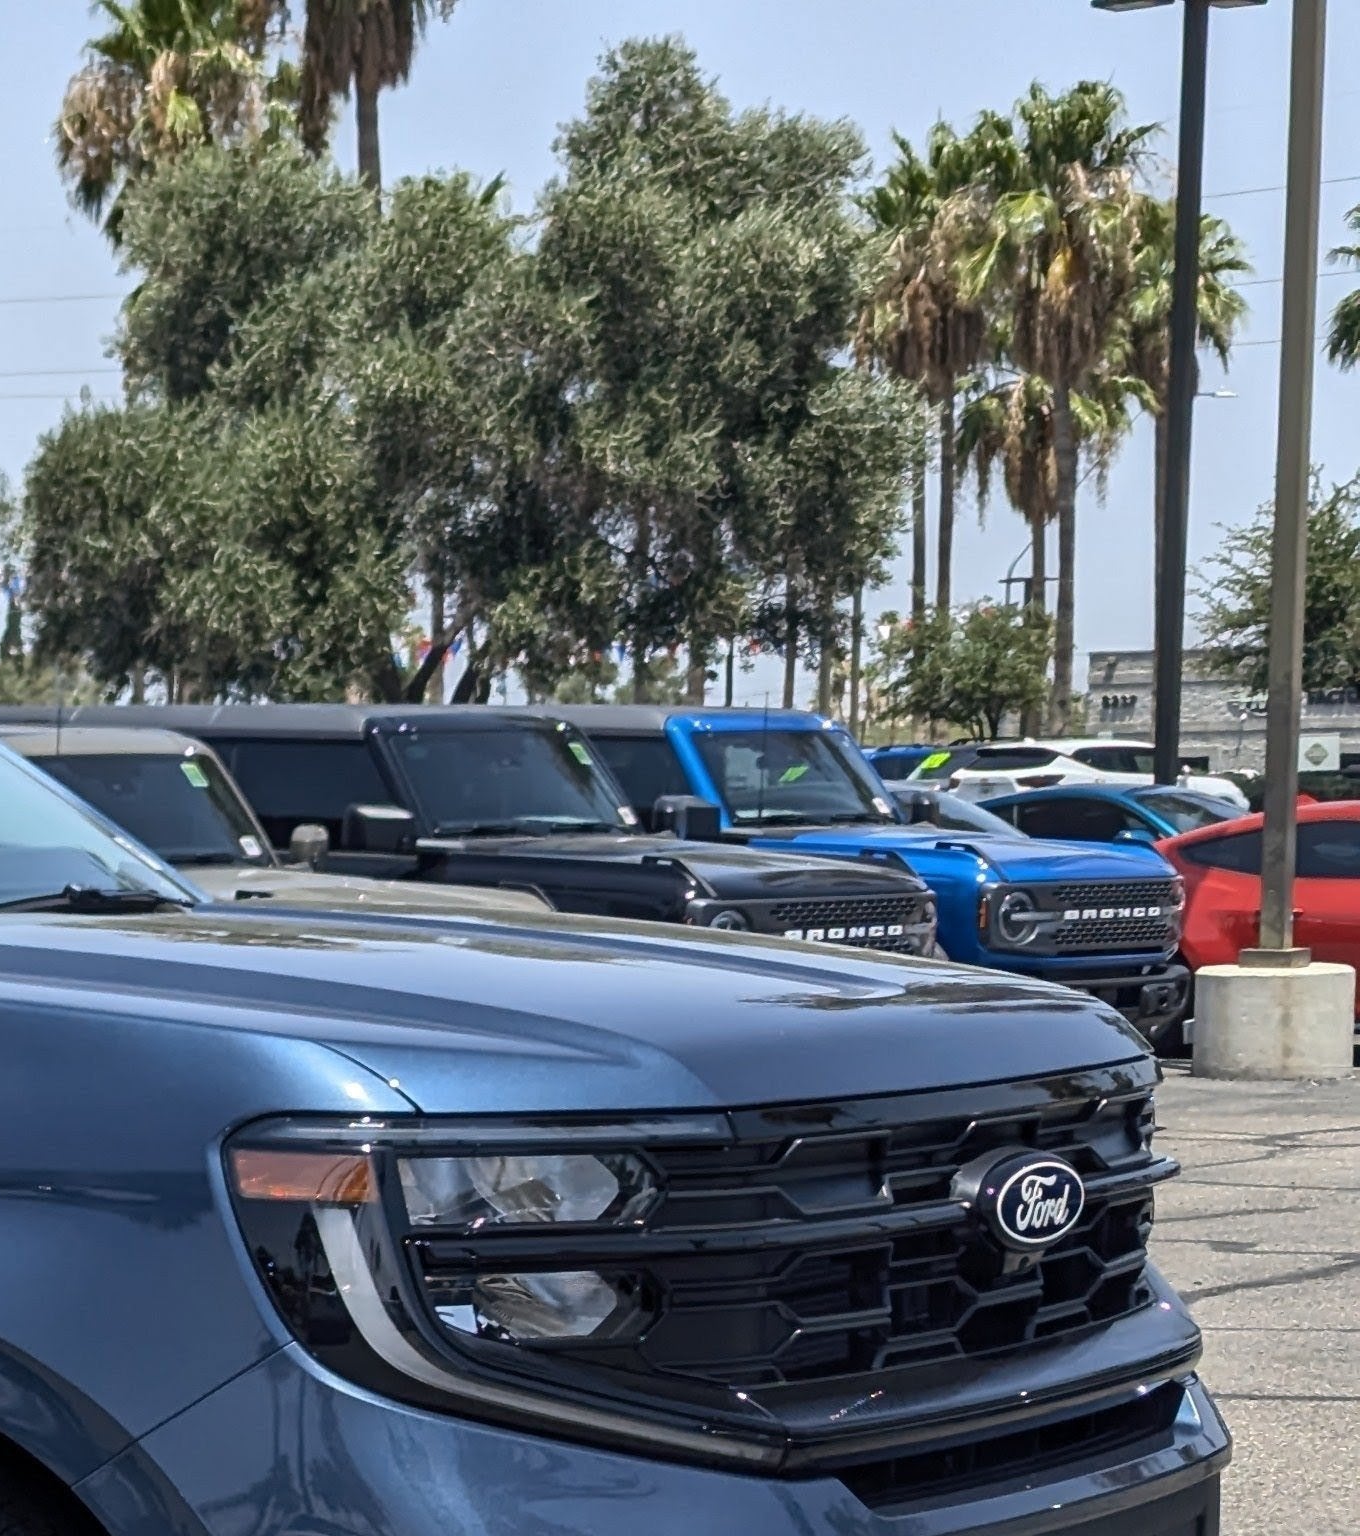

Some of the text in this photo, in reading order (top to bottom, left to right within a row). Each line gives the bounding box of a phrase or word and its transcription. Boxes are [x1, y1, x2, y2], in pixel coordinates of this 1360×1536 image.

[1064, 906, 1160, 920] BRONCO
[784, 924, 904, 942] BRONCO
[1015, 1173, 1071, 1232] Ford
